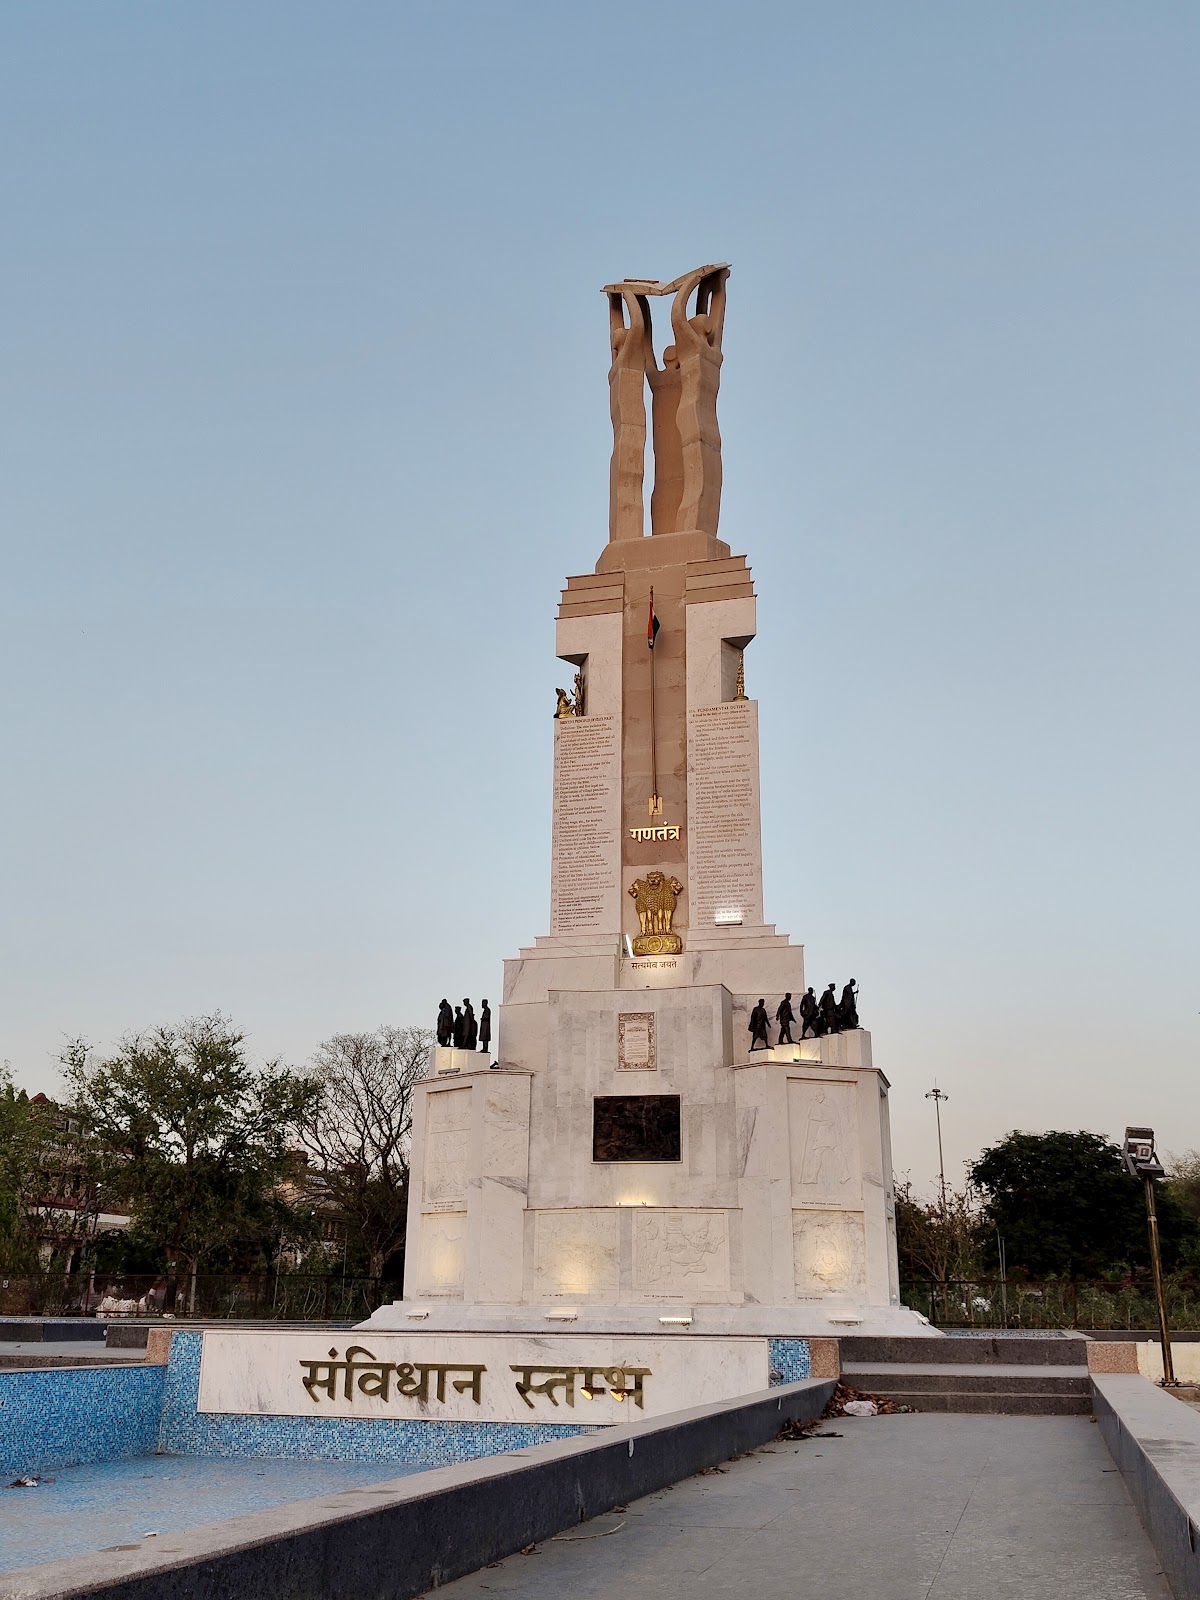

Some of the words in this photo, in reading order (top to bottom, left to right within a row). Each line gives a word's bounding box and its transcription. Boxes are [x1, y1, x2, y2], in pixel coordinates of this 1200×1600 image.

[629, 820, 681, 843] गणतंत्र
[631, 959, 657, 970] सत्यमेव
[659, 957, 677, 969] जयते
[300, 1346, 487, 1404] संविधान
[509, 1364, 652, 1410] स्तम्भ
